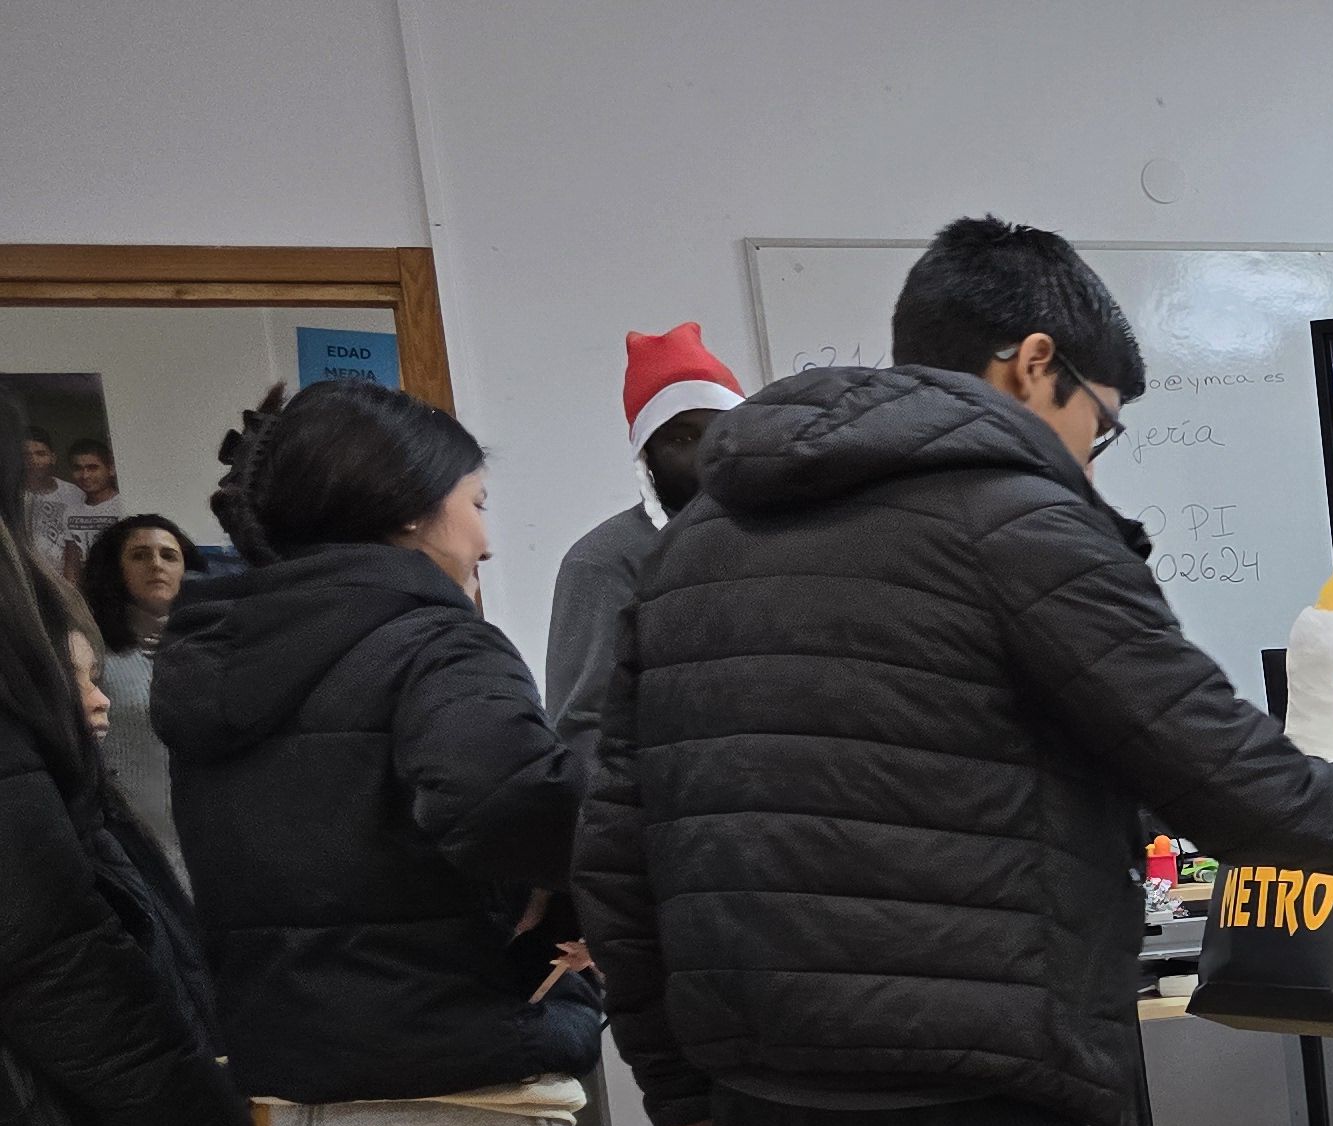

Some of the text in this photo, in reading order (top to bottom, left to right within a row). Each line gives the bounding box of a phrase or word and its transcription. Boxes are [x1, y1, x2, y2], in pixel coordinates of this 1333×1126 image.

[326, 345, 372, 360] EDAD
[325, 367, 377, 382] MEDIA
[1180, 504, 1237, 541] PI
[1155, 546, 1261, 584] 02624
